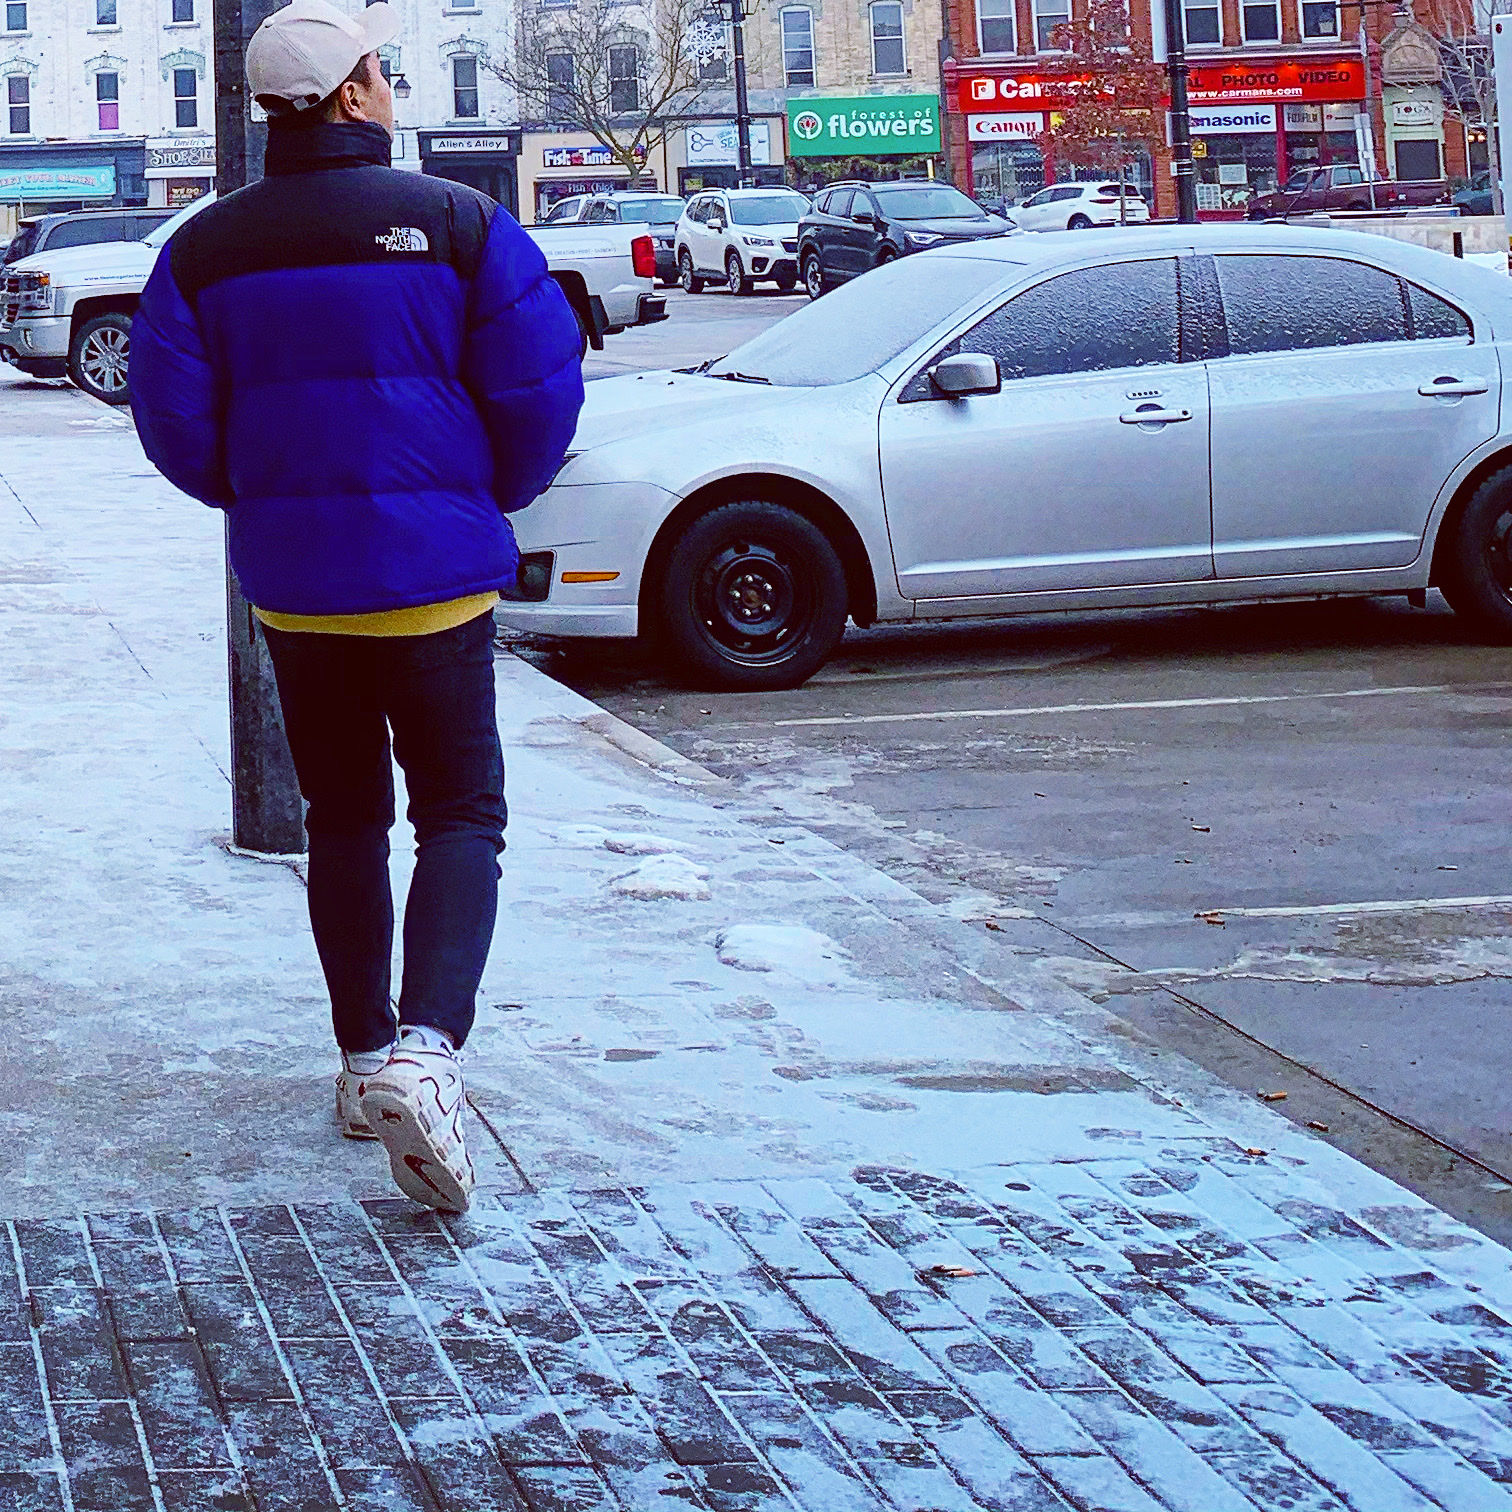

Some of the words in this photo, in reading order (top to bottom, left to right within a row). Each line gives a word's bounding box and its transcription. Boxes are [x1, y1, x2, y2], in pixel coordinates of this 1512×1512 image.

[1221, 72, 1279, 87] PHOTO
[1297, 70, 1351, 84] VIDEO
[1187, 87, 1303, 98] www.carmans.com
[851, 109, 904, 120] forest
[914, 107, 931, 118] of
[1188, 112, 1271, 128] anasonic
[828, 114, 934, 138] flowers
[544, 149, 571, 166] Fish
[578, 149, 612, 164] Time
[389, 227, 410, 236] THE
[375, 235, 411, 245] NORTH
[385, 242, 412, 252] FACE
